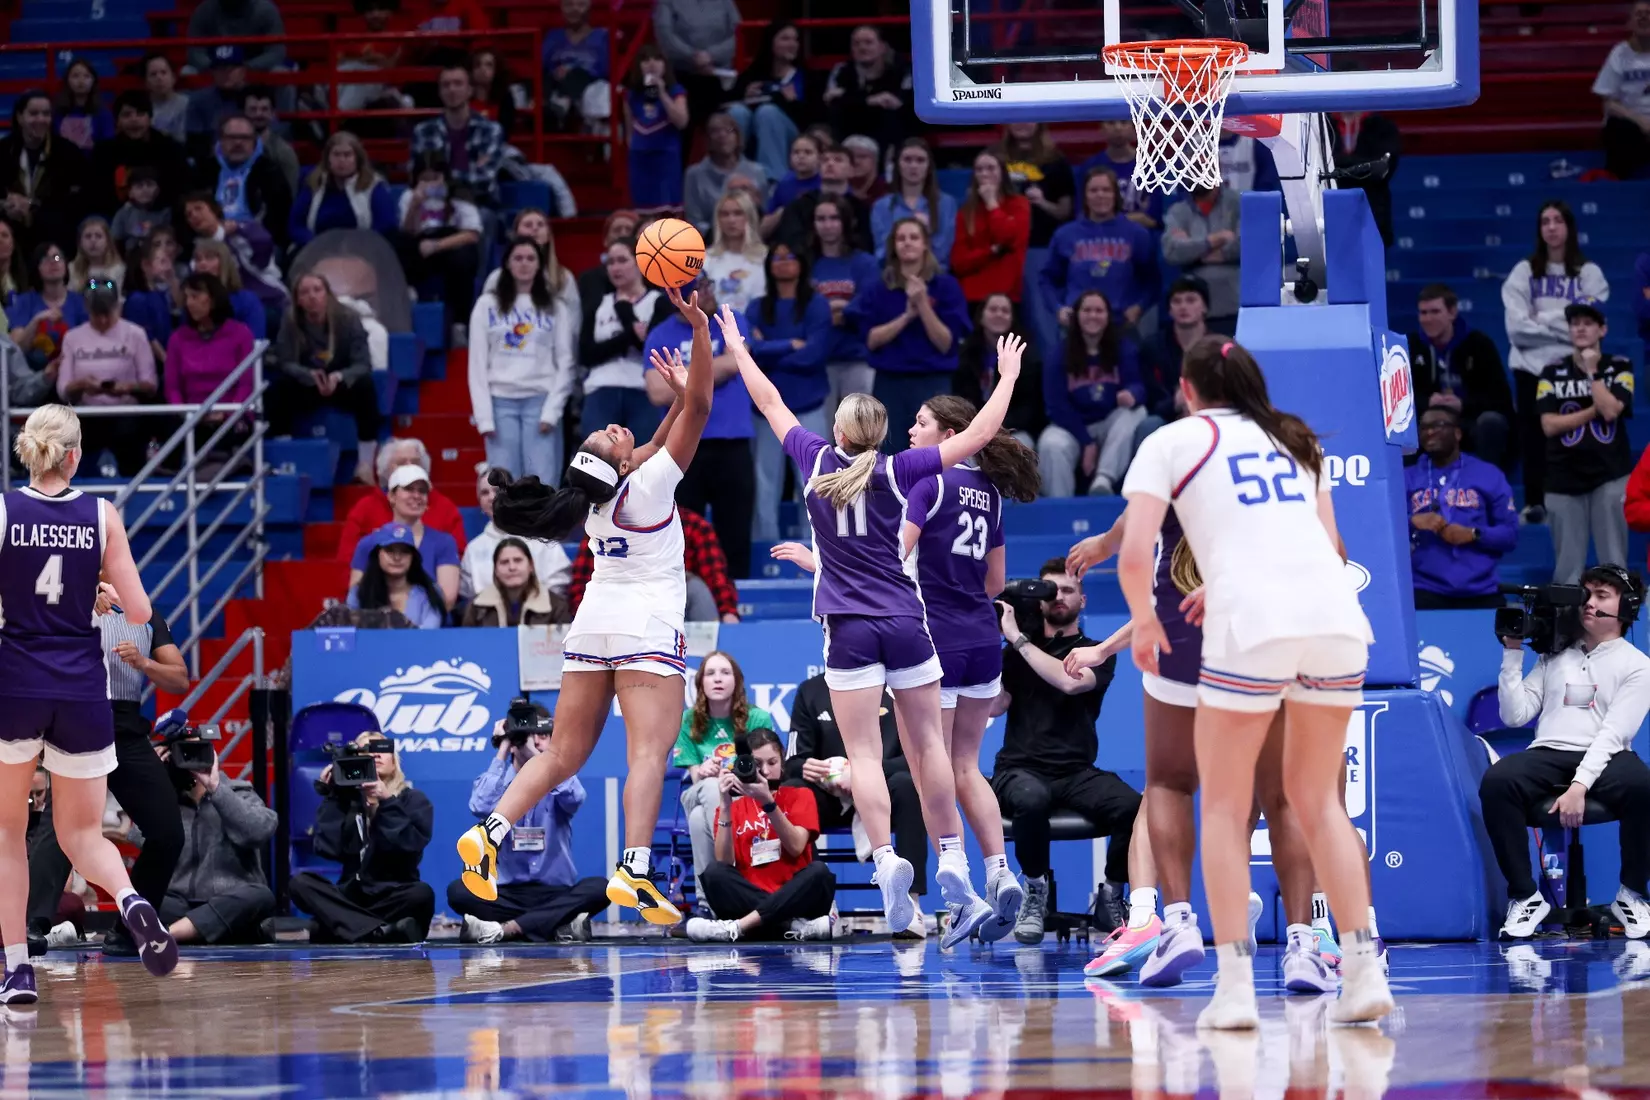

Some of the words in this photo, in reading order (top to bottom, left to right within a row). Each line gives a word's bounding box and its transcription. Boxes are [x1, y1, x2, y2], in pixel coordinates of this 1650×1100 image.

[952, 87, 1002, 101] SPALDING
[1227, 452, 1306, 505] 52
[11, 523, 95, 549] CLAESSENS
[835, 489, 867, 537] 11
[951, 511, 988, 560] 23
[35, 554, 64, 605] 4
[394, 738, 487, 752] WASH
